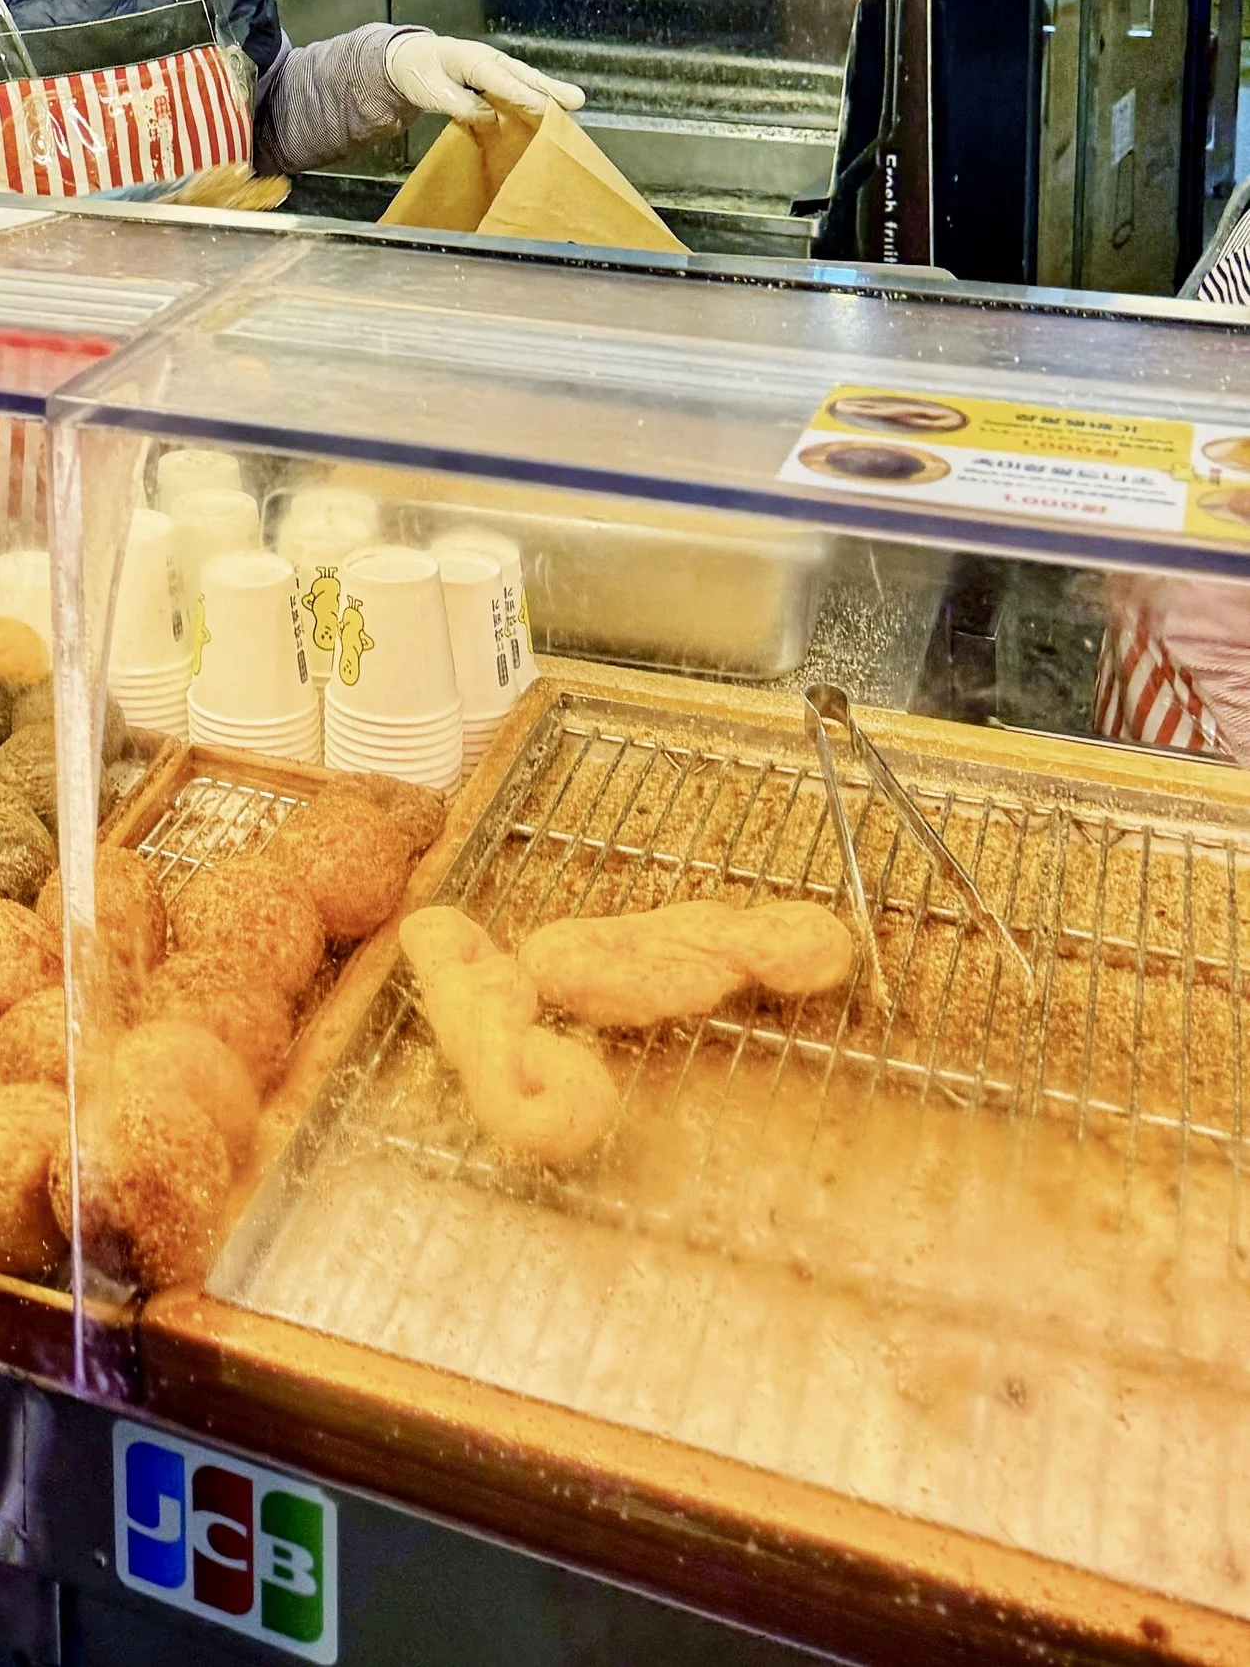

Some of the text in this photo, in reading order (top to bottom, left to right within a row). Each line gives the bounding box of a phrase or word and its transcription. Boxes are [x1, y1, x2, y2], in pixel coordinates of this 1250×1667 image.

[1022, 438, 1120, 458] 1,000원
[1001, 493, 1109, 515] 1,000원
[126, 1494, 318, 1598] JCB
